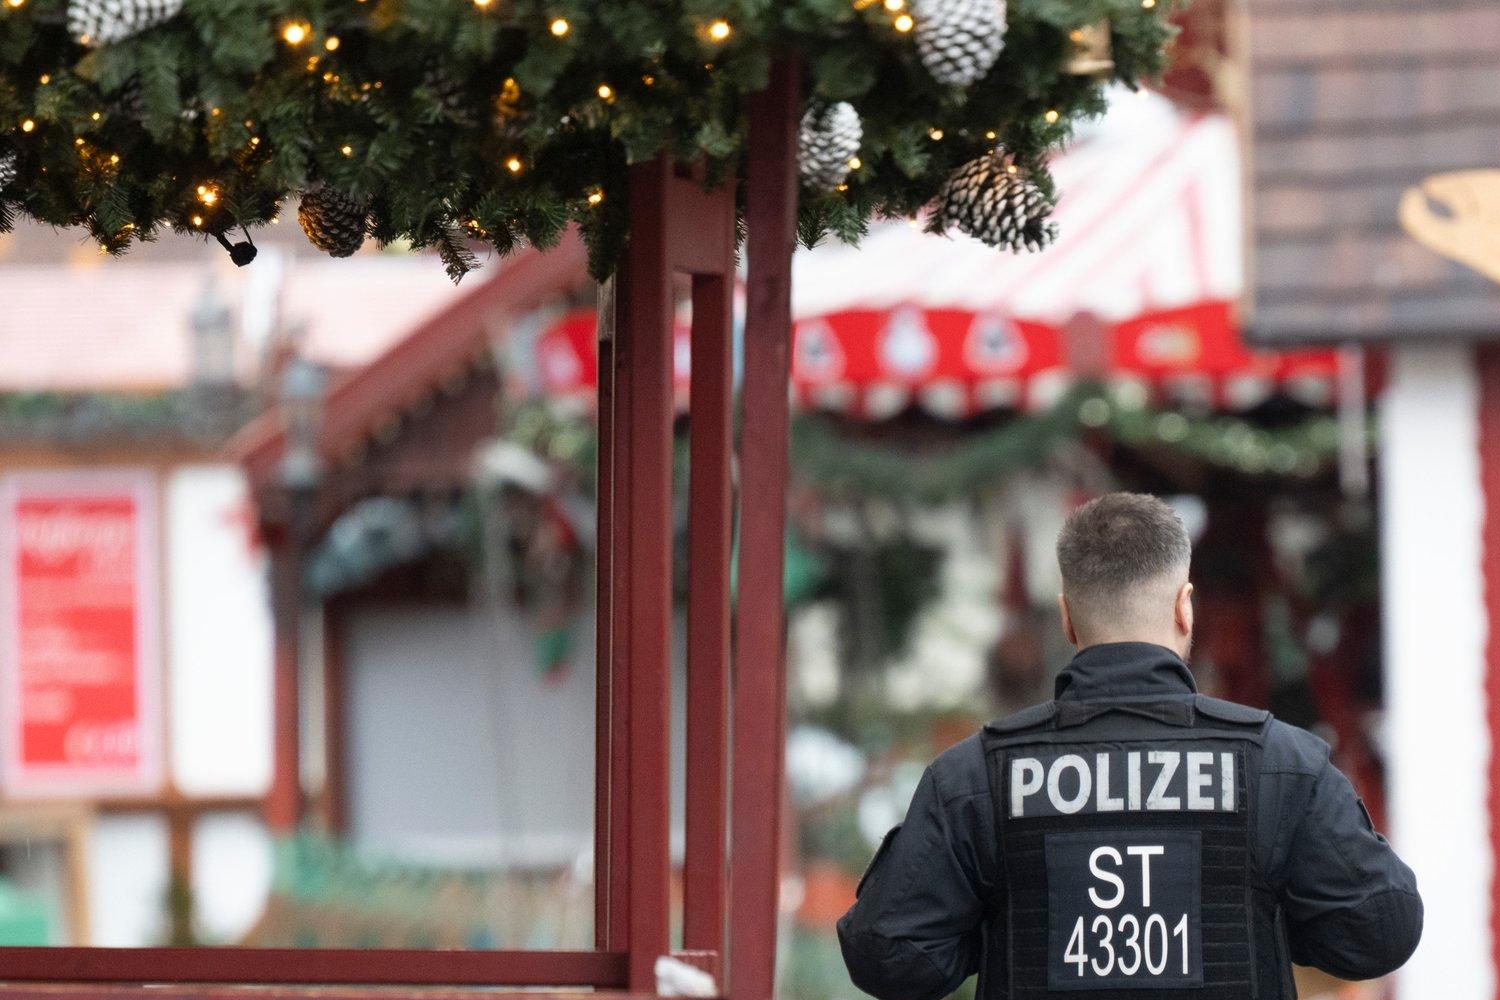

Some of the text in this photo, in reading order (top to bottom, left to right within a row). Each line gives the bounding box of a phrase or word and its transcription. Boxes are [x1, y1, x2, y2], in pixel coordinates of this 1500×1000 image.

[1011, 750, 1235, 817] POLIZEI
[1088, 845, 1164, 909] ST
[1063, 913, 1188, 977] 43301
